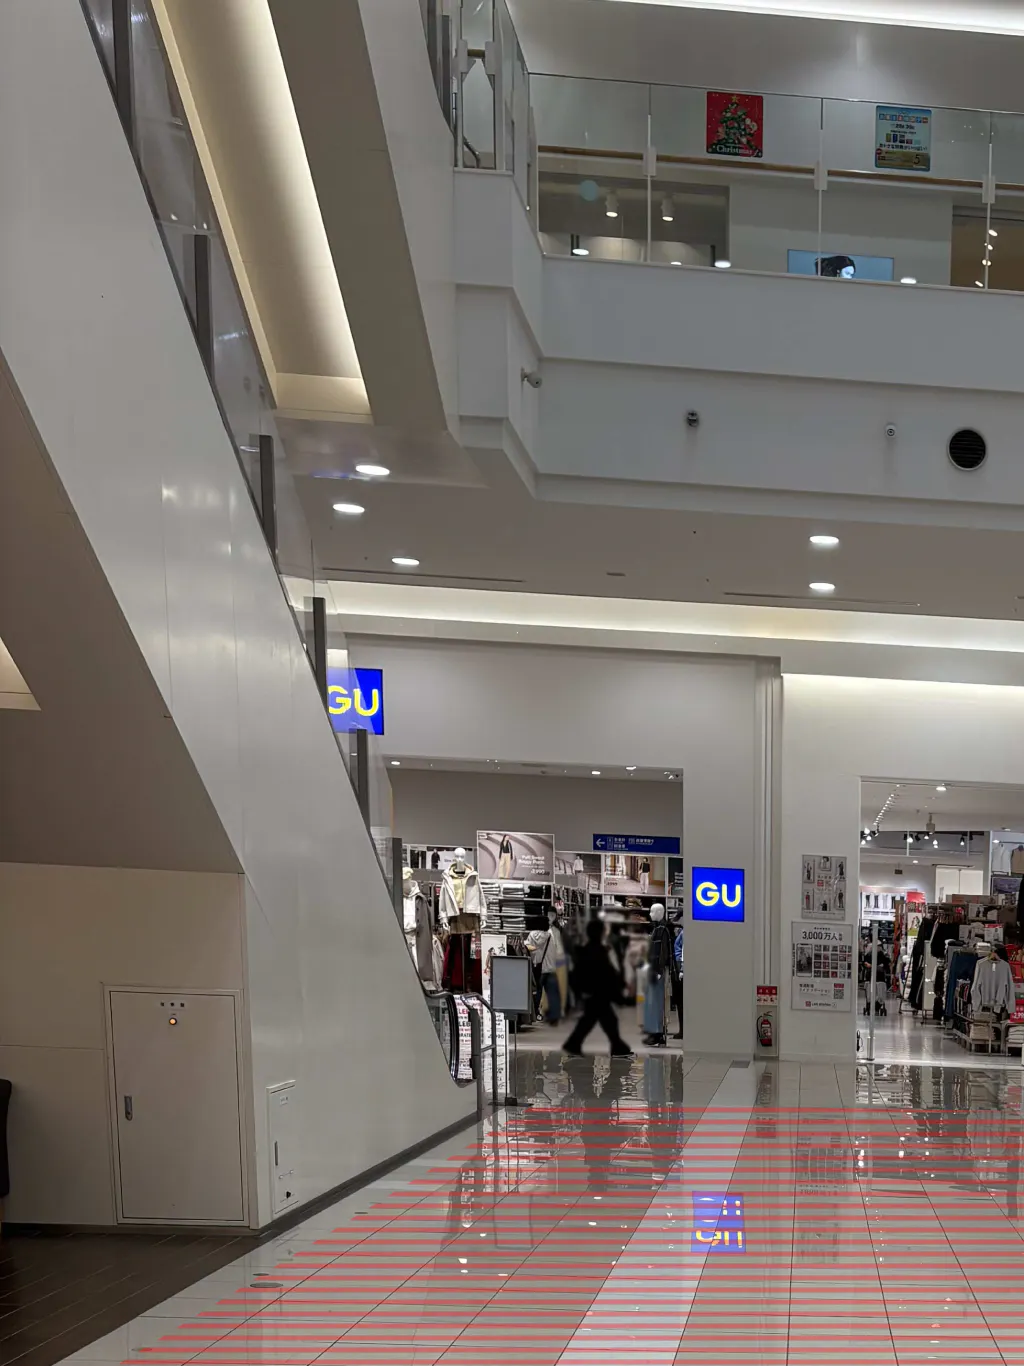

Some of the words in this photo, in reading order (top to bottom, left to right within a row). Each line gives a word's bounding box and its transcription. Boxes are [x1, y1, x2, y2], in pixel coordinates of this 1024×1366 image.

[716, 144, 753, 155] Christmas
[327, 685, 379, 717] GU
[695, 881, 742, 908] GU
